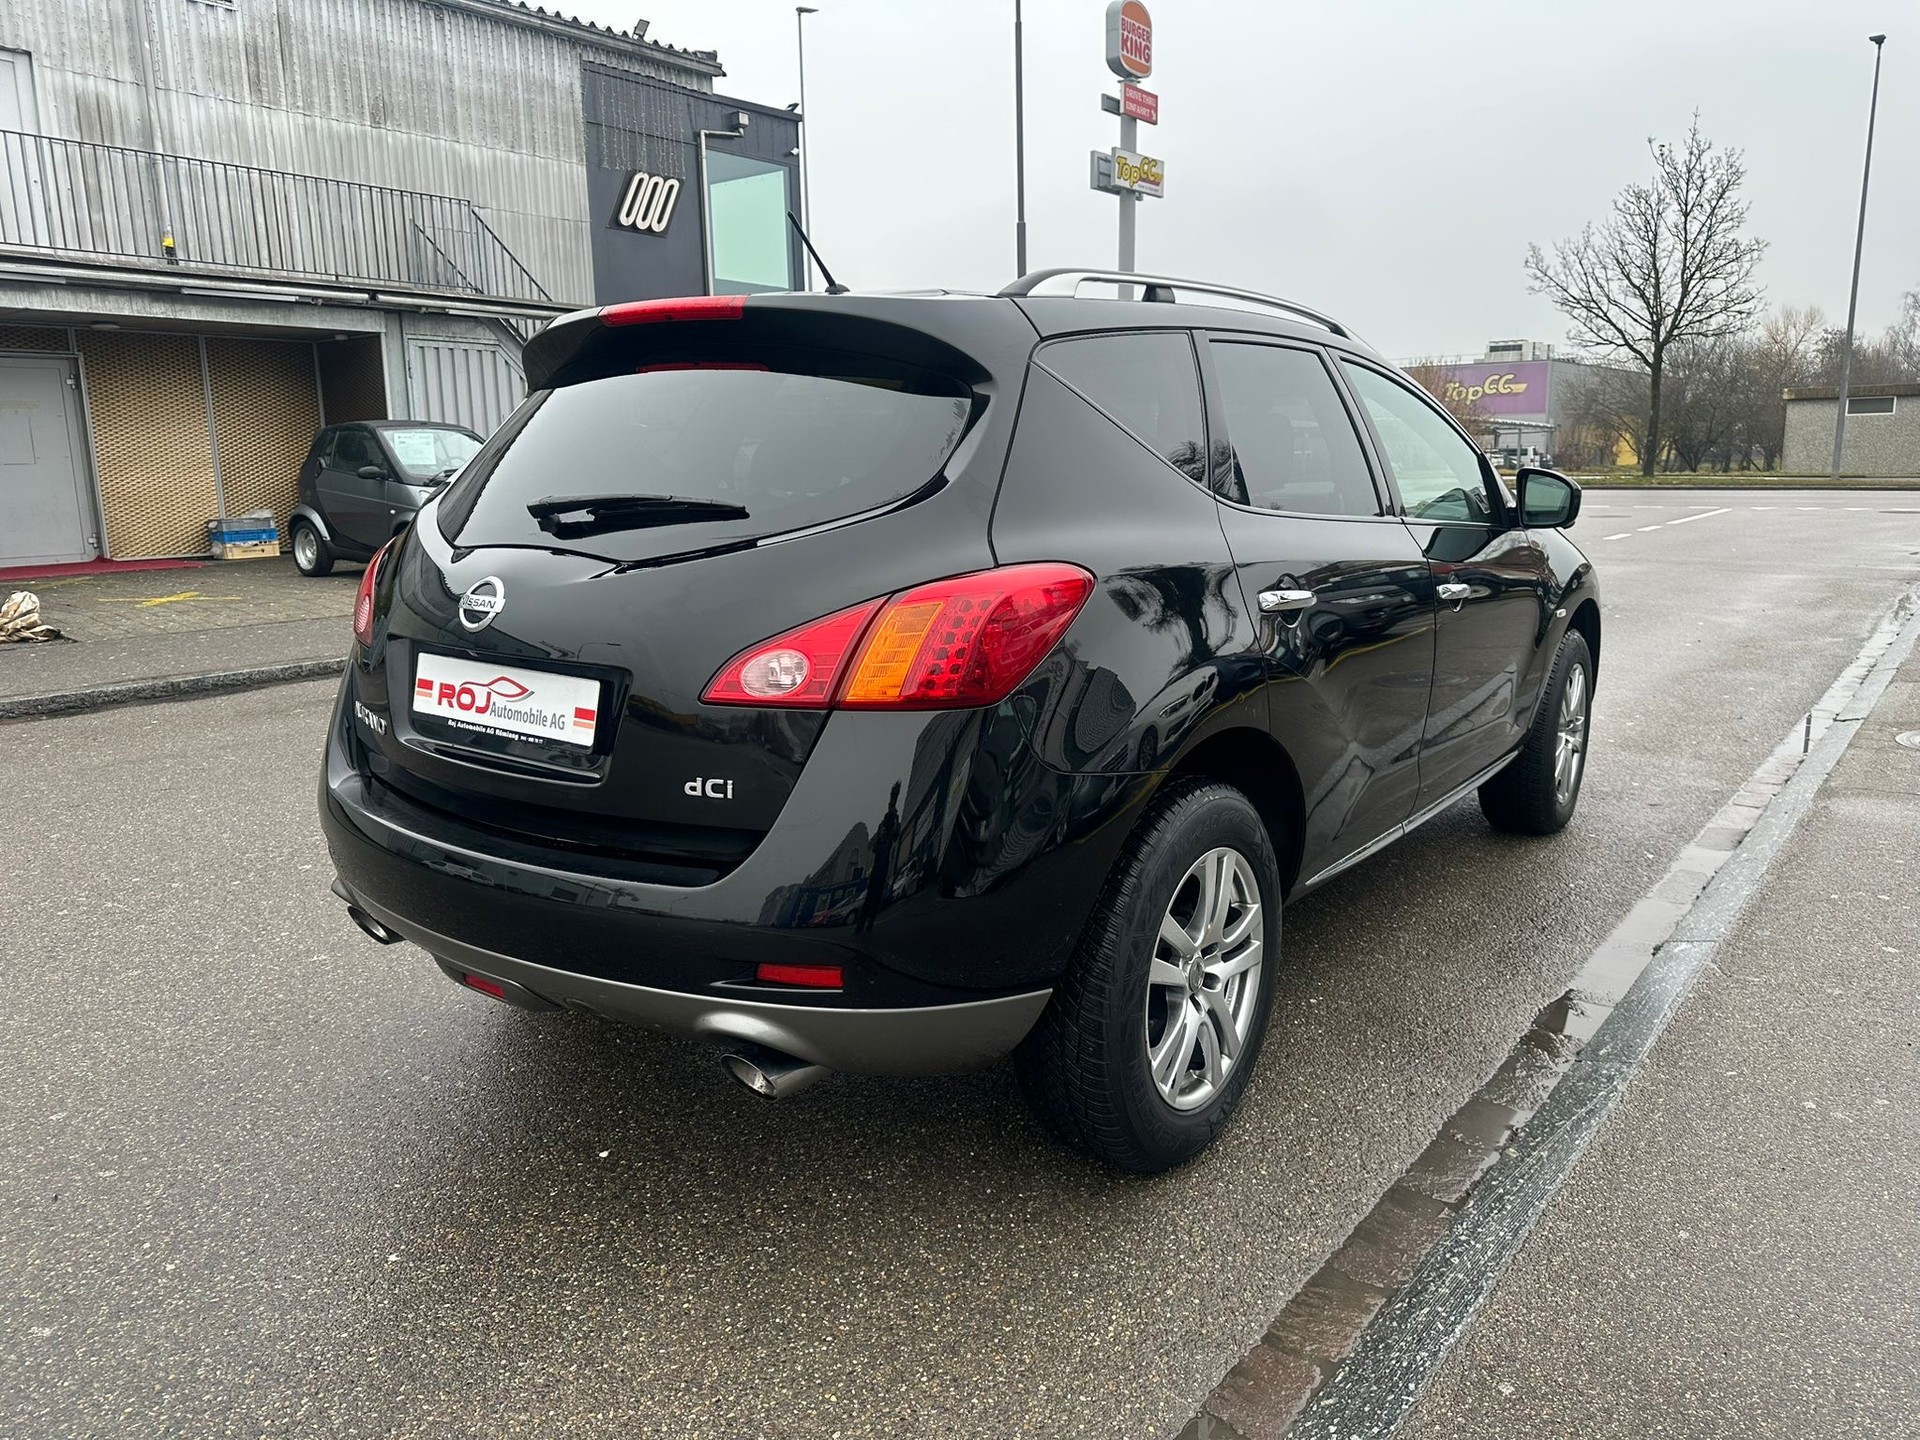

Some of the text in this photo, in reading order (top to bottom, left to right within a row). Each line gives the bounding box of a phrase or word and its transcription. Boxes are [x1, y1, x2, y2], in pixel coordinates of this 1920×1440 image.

[1121, 17, 1150, 44] BURGER
[1121, 32, 1150, 64] KING
[462, 595, 496, 609] NISSAN
[437, 682, 492, 714] ROJ
[447, 718, 457, 729] Roj
[457, 720, 486, 734] Automobile
[486, 727, 495, 735] AG
[489, 701, 566, 731] Automobile AG
[684, 777, 734, 799] dCi
